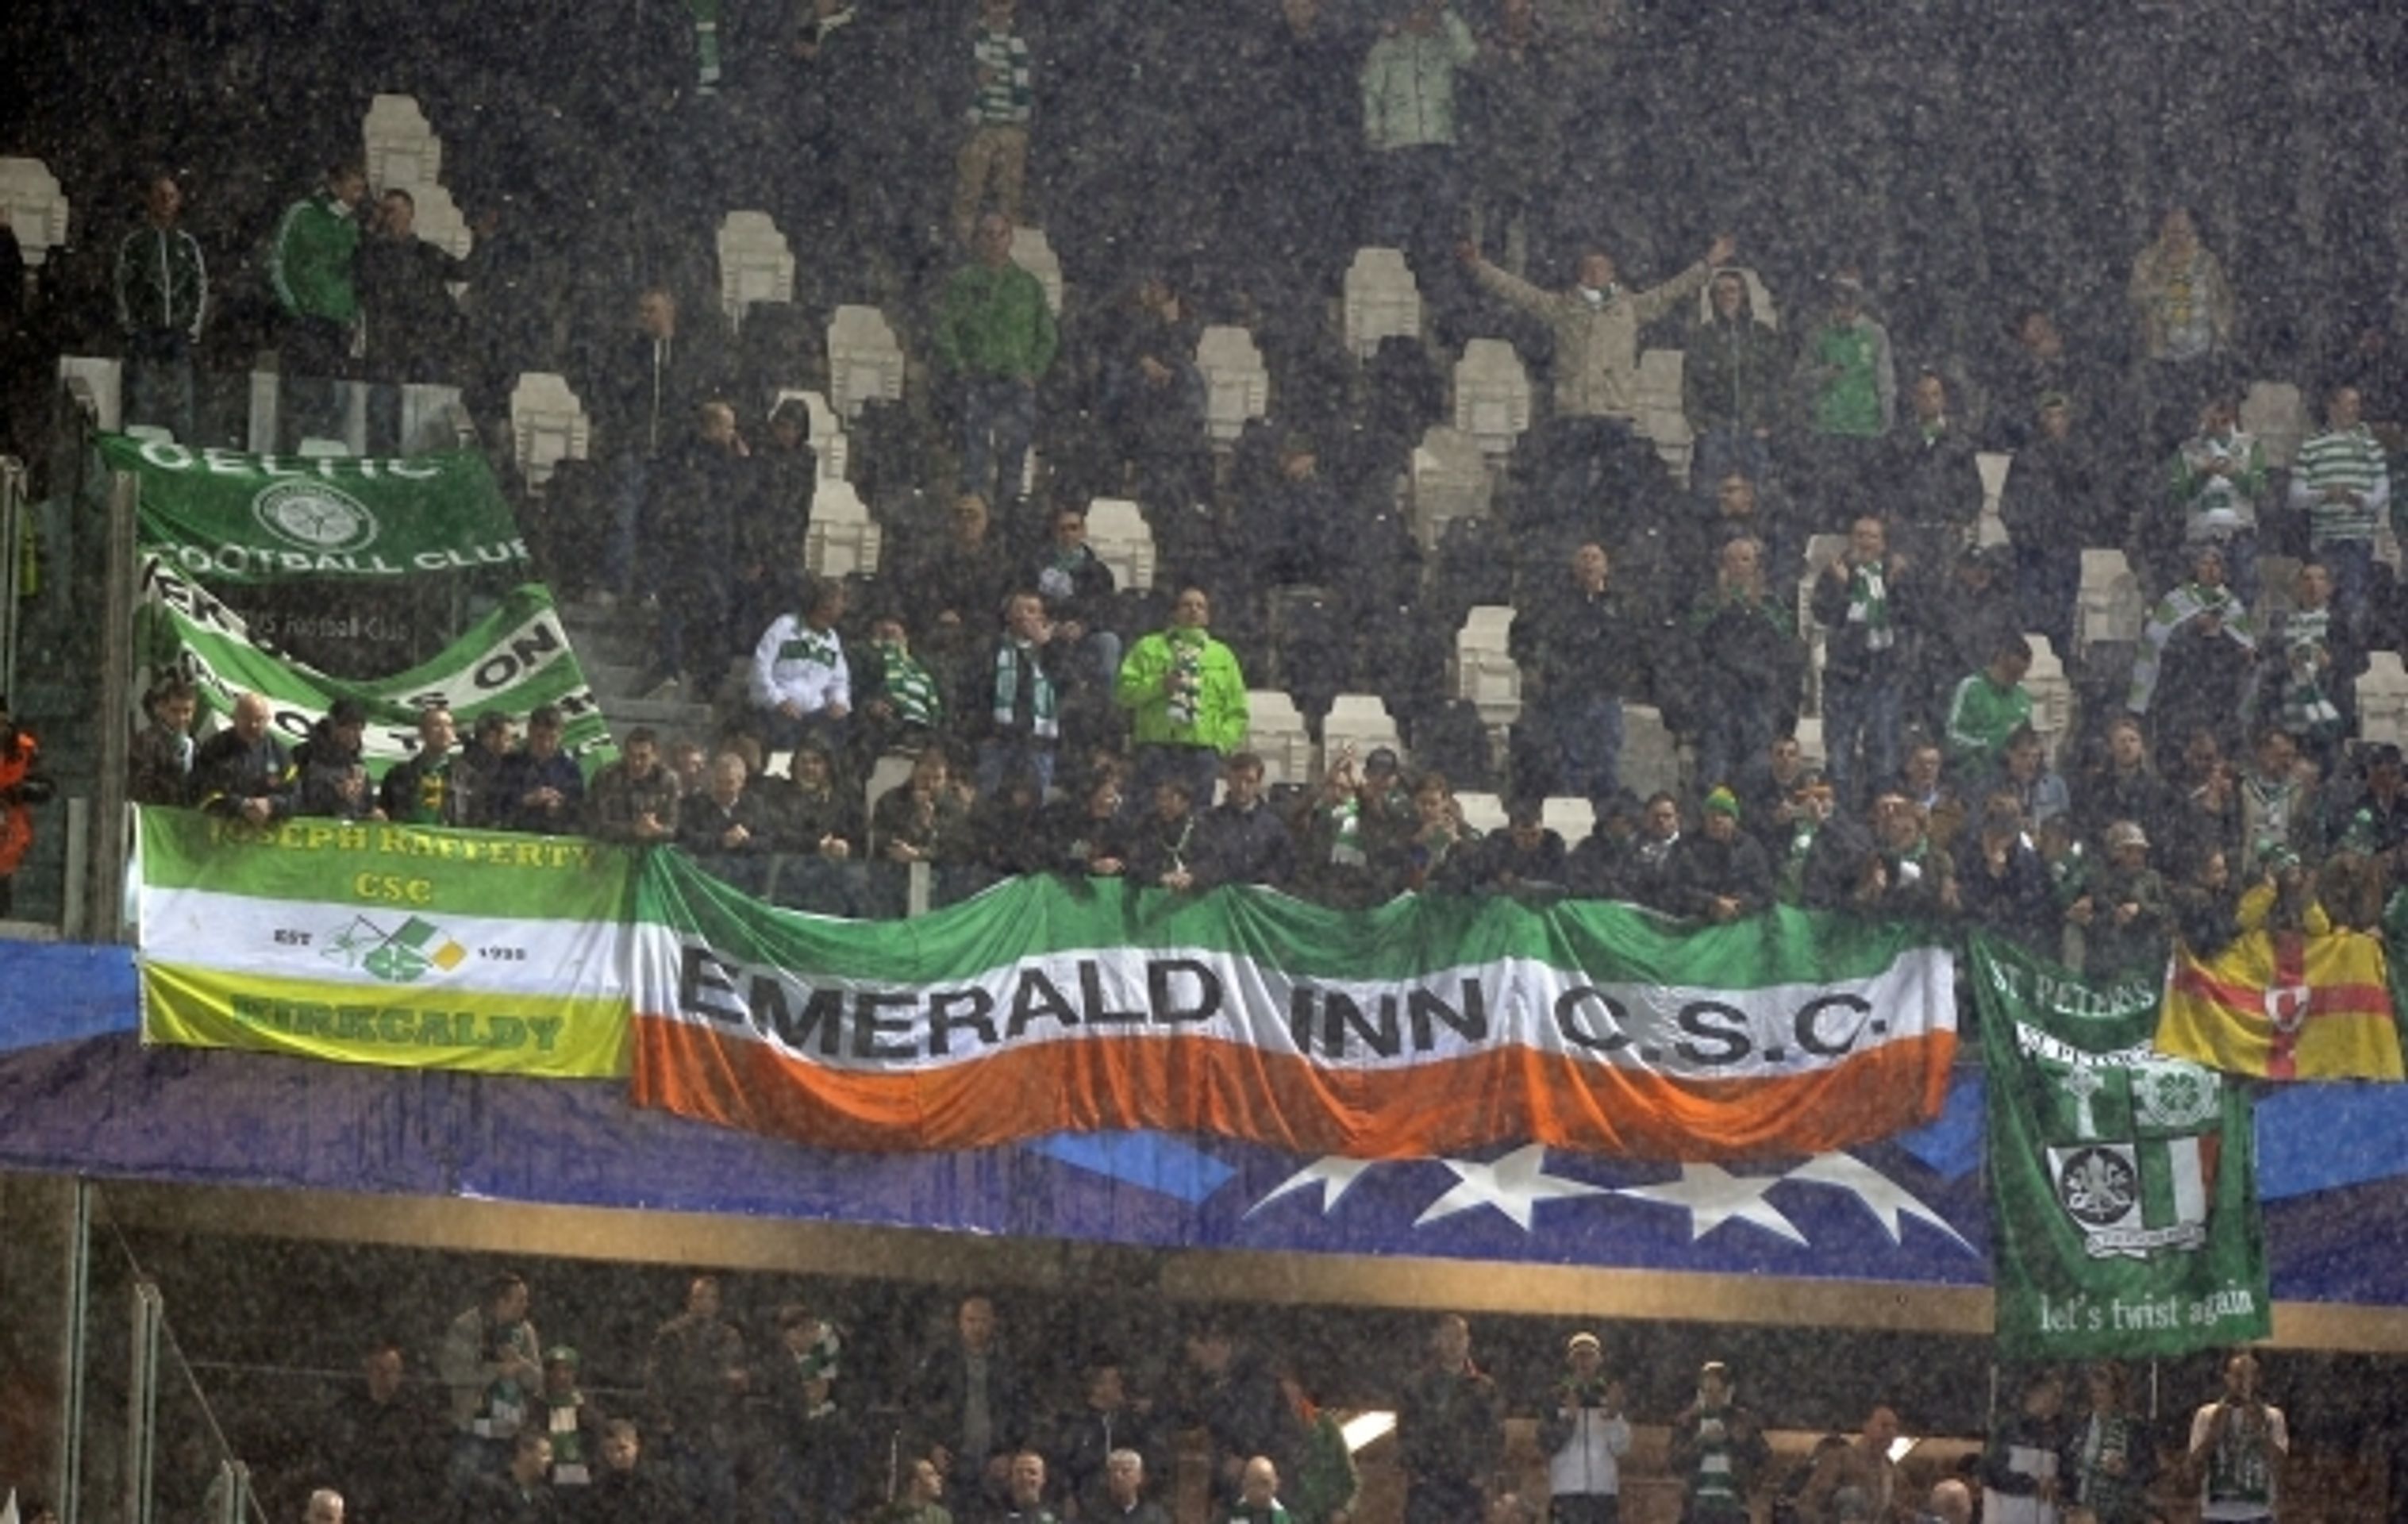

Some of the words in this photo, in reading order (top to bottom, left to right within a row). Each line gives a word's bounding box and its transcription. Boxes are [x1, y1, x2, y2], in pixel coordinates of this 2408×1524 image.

[356, 873, 432, 903] CSC
[273, 927, 313, 946] EST
[231, 995, 563, 1050] KIRKCALDY
[679, 949, 1224, 1060] EMERALD
[1290, 977, 1489, 1060] INN
[1553, 984, 1887, 1065] C.S.C.
[2040, 1294, 2102, 1330] let's
[2112, 1291, 2179, 1330] twist
